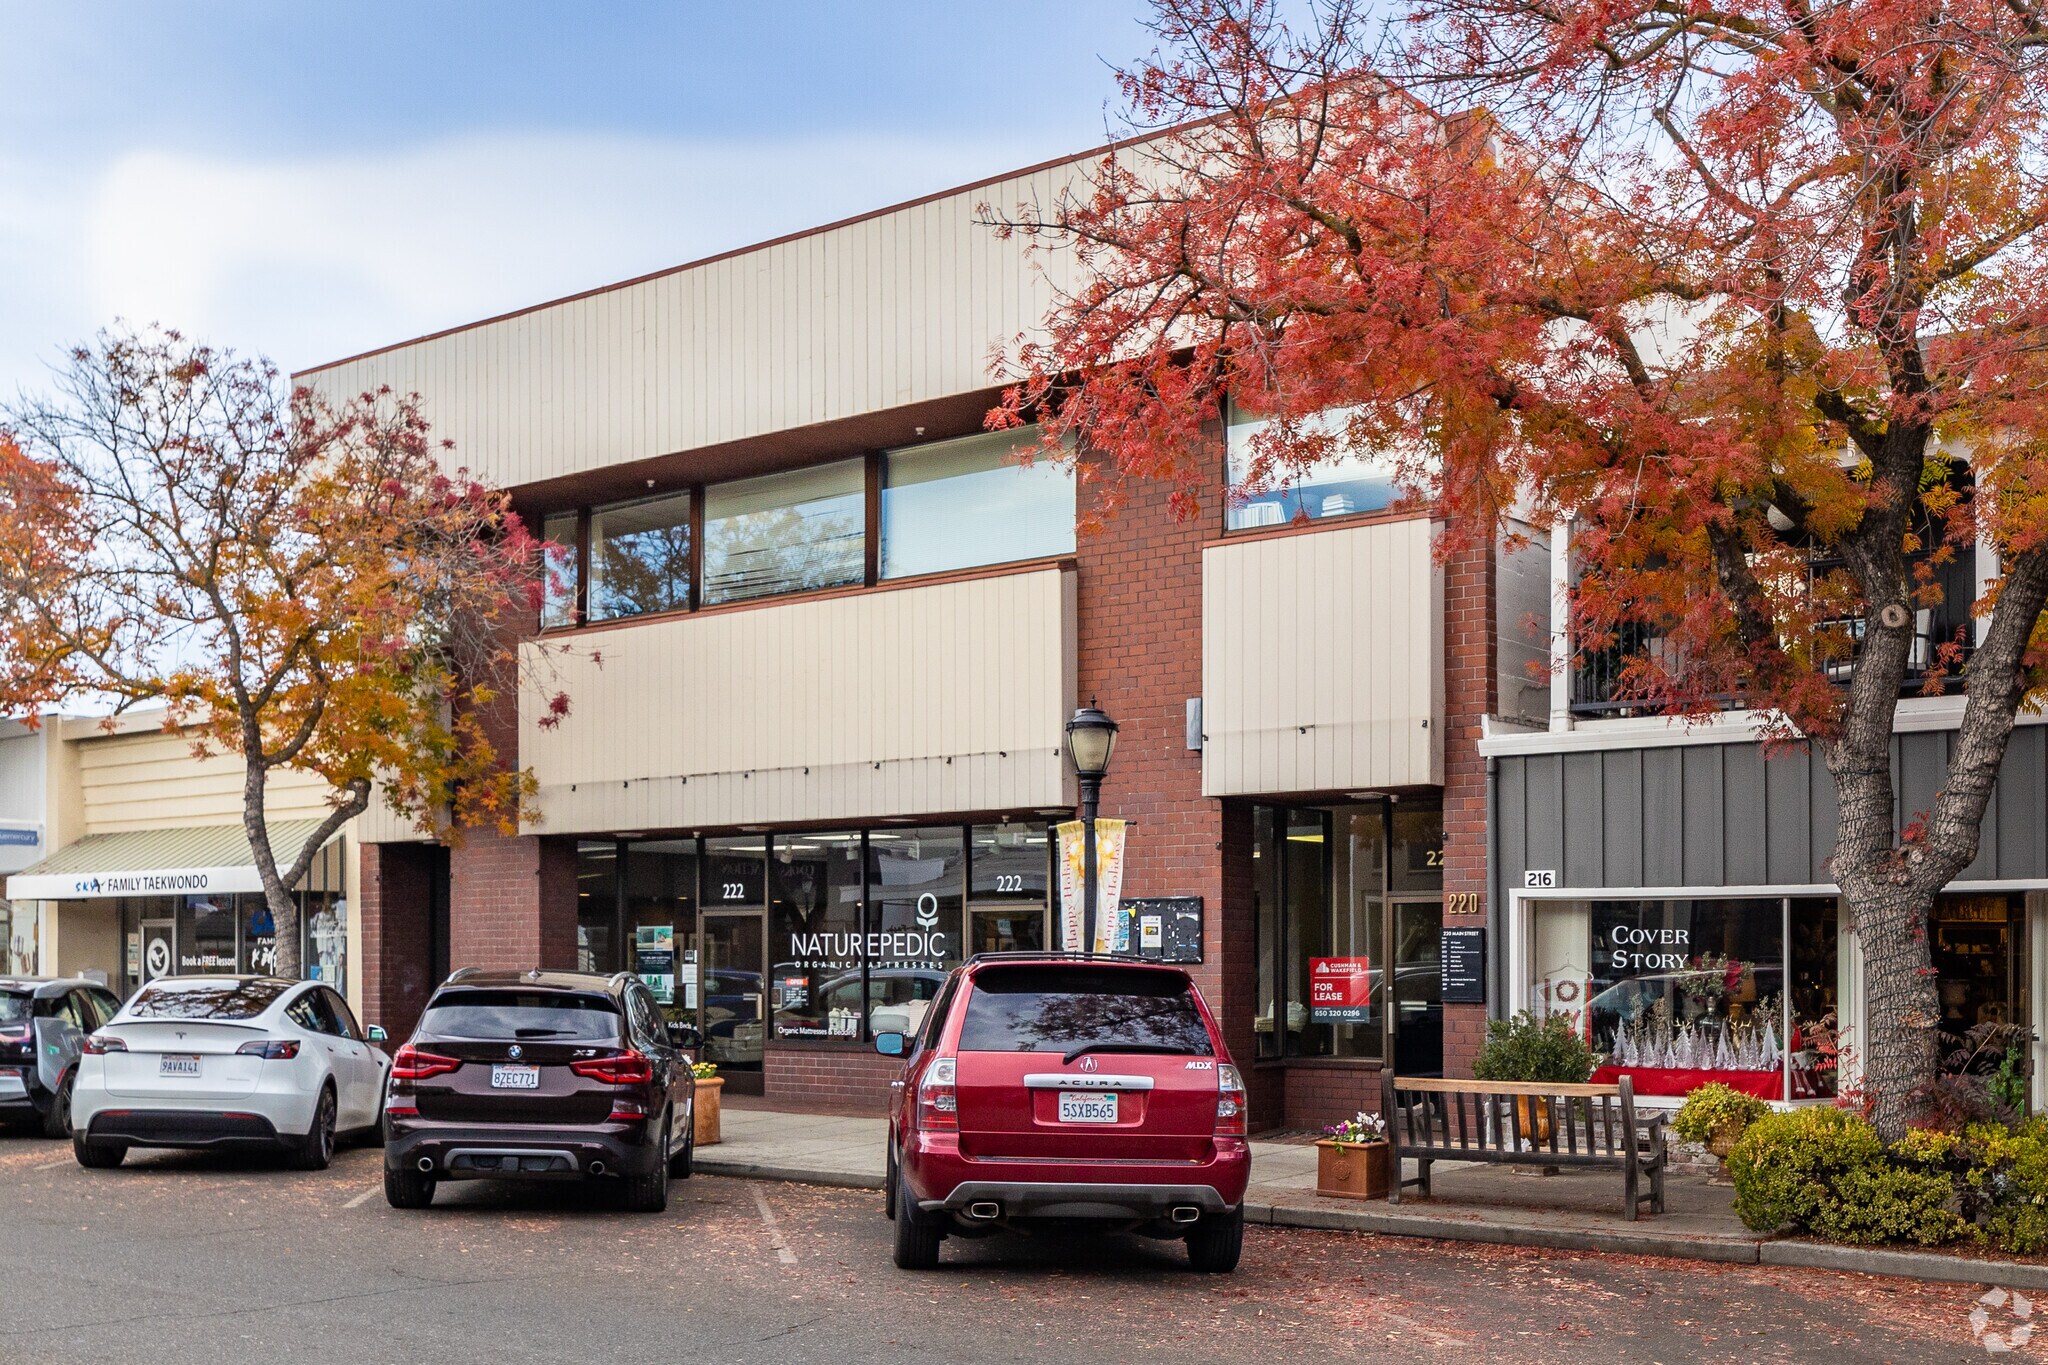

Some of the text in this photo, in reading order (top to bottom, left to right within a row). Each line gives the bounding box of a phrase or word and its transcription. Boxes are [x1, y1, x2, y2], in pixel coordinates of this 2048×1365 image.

[1108, 833, 1122, 896] Holidays
[1426, 850, 1444, 866] 22
[108, 878, 141, 892] FAMILY
[143, 874, 208, 891] TAEKWONDO
[996, 874, 1023, 892] 222
[1528, 872, 1552, 887] 216
[723, 883, 745, 899] 222
[1062, 836, 1078, 949] Happy Holidays
[1448, 893, 1478, 914] 220
[257, 937, 276, 945] FAMI
[791, 932, 946, 957] NATUREPEDIC
[181, 955, 197, 967] Book
[197, 958, 202, 966] a
[202, 955, 216, 967] FREE
[794, 961, 851, 969] ORGANIC
[1314, 983, 1333, 991] FOR
[1314, 992, 1343, 1001] LEASE
[667, 1021, 678, 1029] Kids
[778, 1026, 799, 1036] Organic
[799, 1026, 828, 1036] Mattresses
[834, 1028, 858, 1038] Bedding
[162, 1061, 198, 1072] 9AVA141
[1184, 1061, 1213, 1070] MDX
[494, 1072, 536, 1085] 8ZEC771
[1063, 1103, 1114, 1118] 5SXB565
